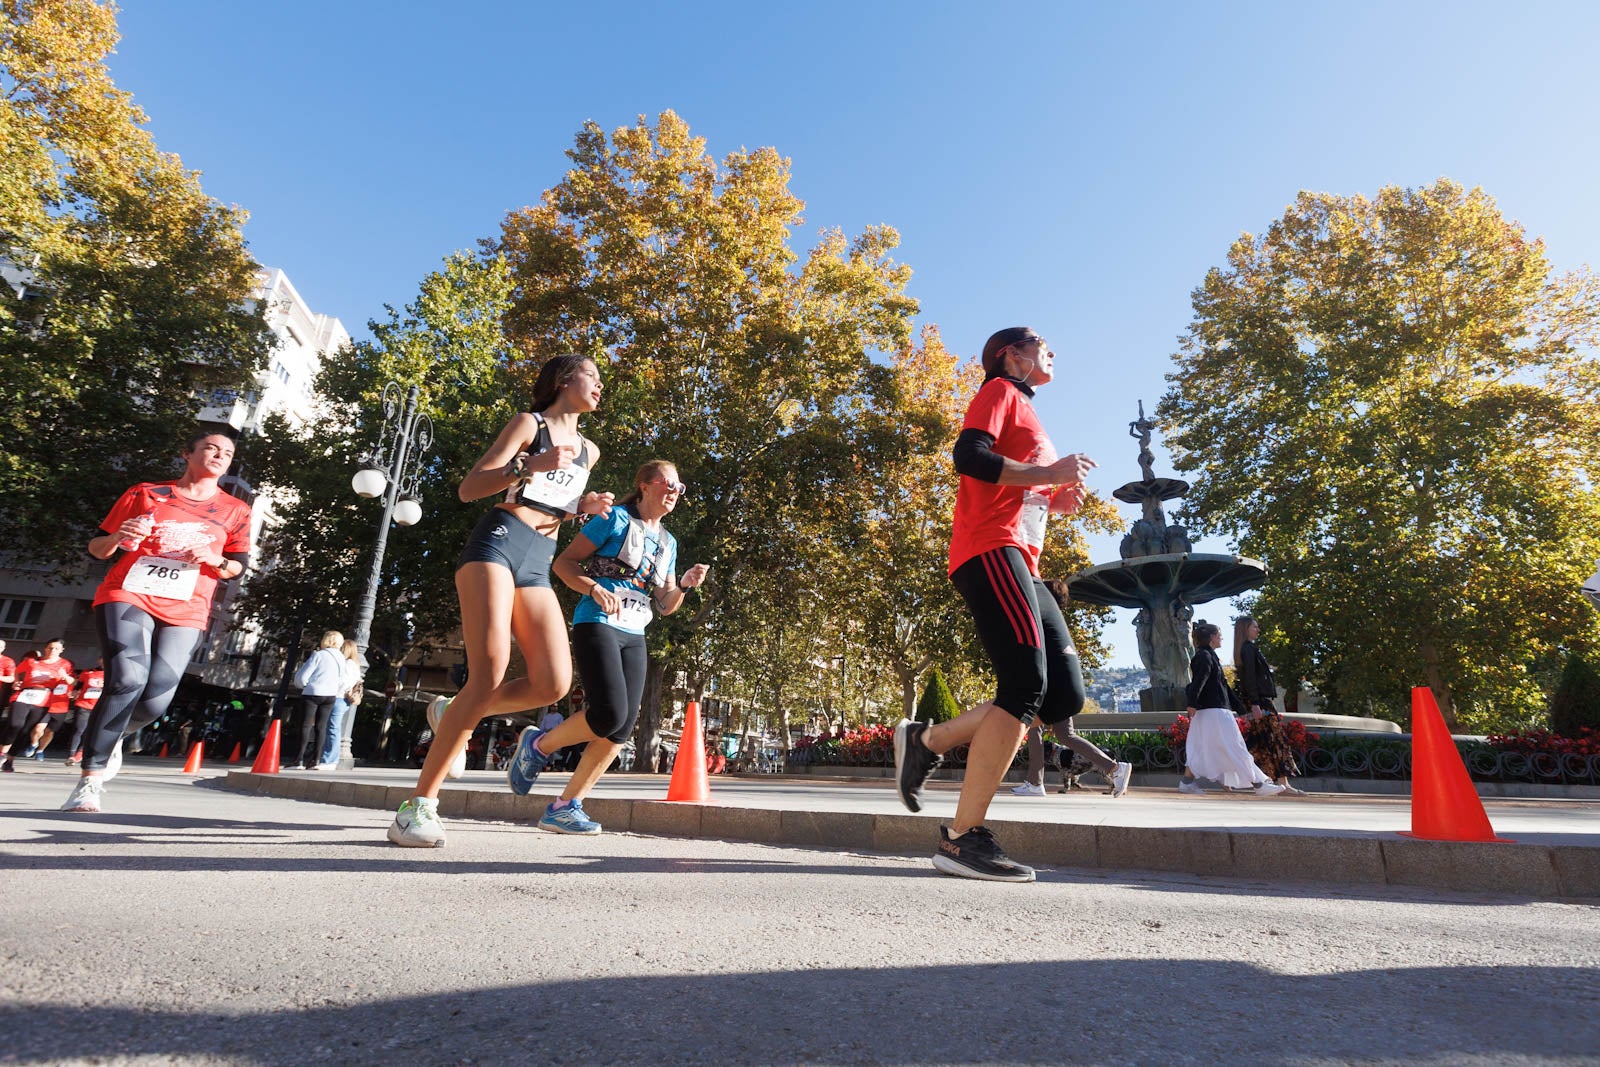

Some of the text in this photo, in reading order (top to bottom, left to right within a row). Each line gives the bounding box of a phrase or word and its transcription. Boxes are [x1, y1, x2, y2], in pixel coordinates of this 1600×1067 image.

[546, 470, 574, 487] 837
[147, 564, 181, 580] 786
[940, 839, 960, 856] HOKA
